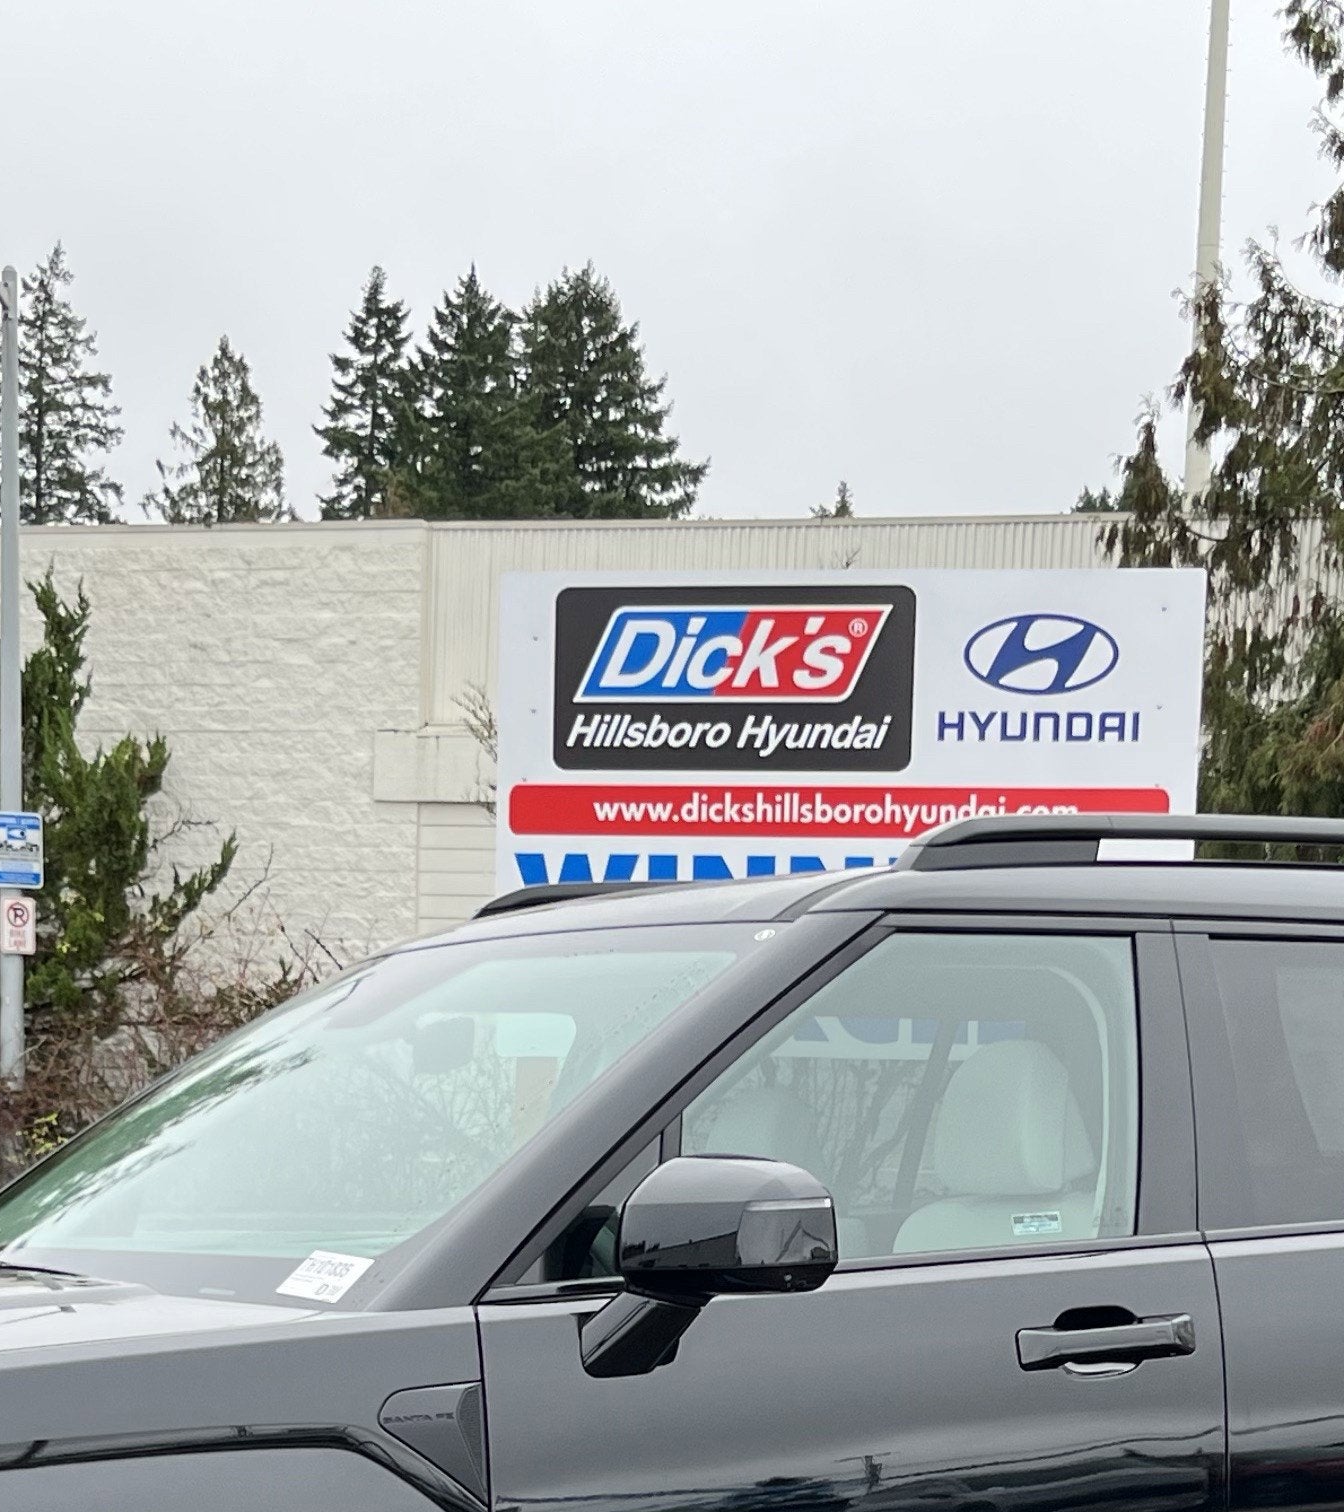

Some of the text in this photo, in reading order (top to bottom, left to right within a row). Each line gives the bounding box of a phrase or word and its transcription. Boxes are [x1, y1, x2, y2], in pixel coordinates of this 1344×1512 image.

[599, 617, 852, 689] Dick's
[566, 714, 892, 757] Hillsboro Hyundai
[937, 711, 1140, 742] HYUNDAI
[594, 791, 1080, 832] www.dickshillsborohyundaicom
